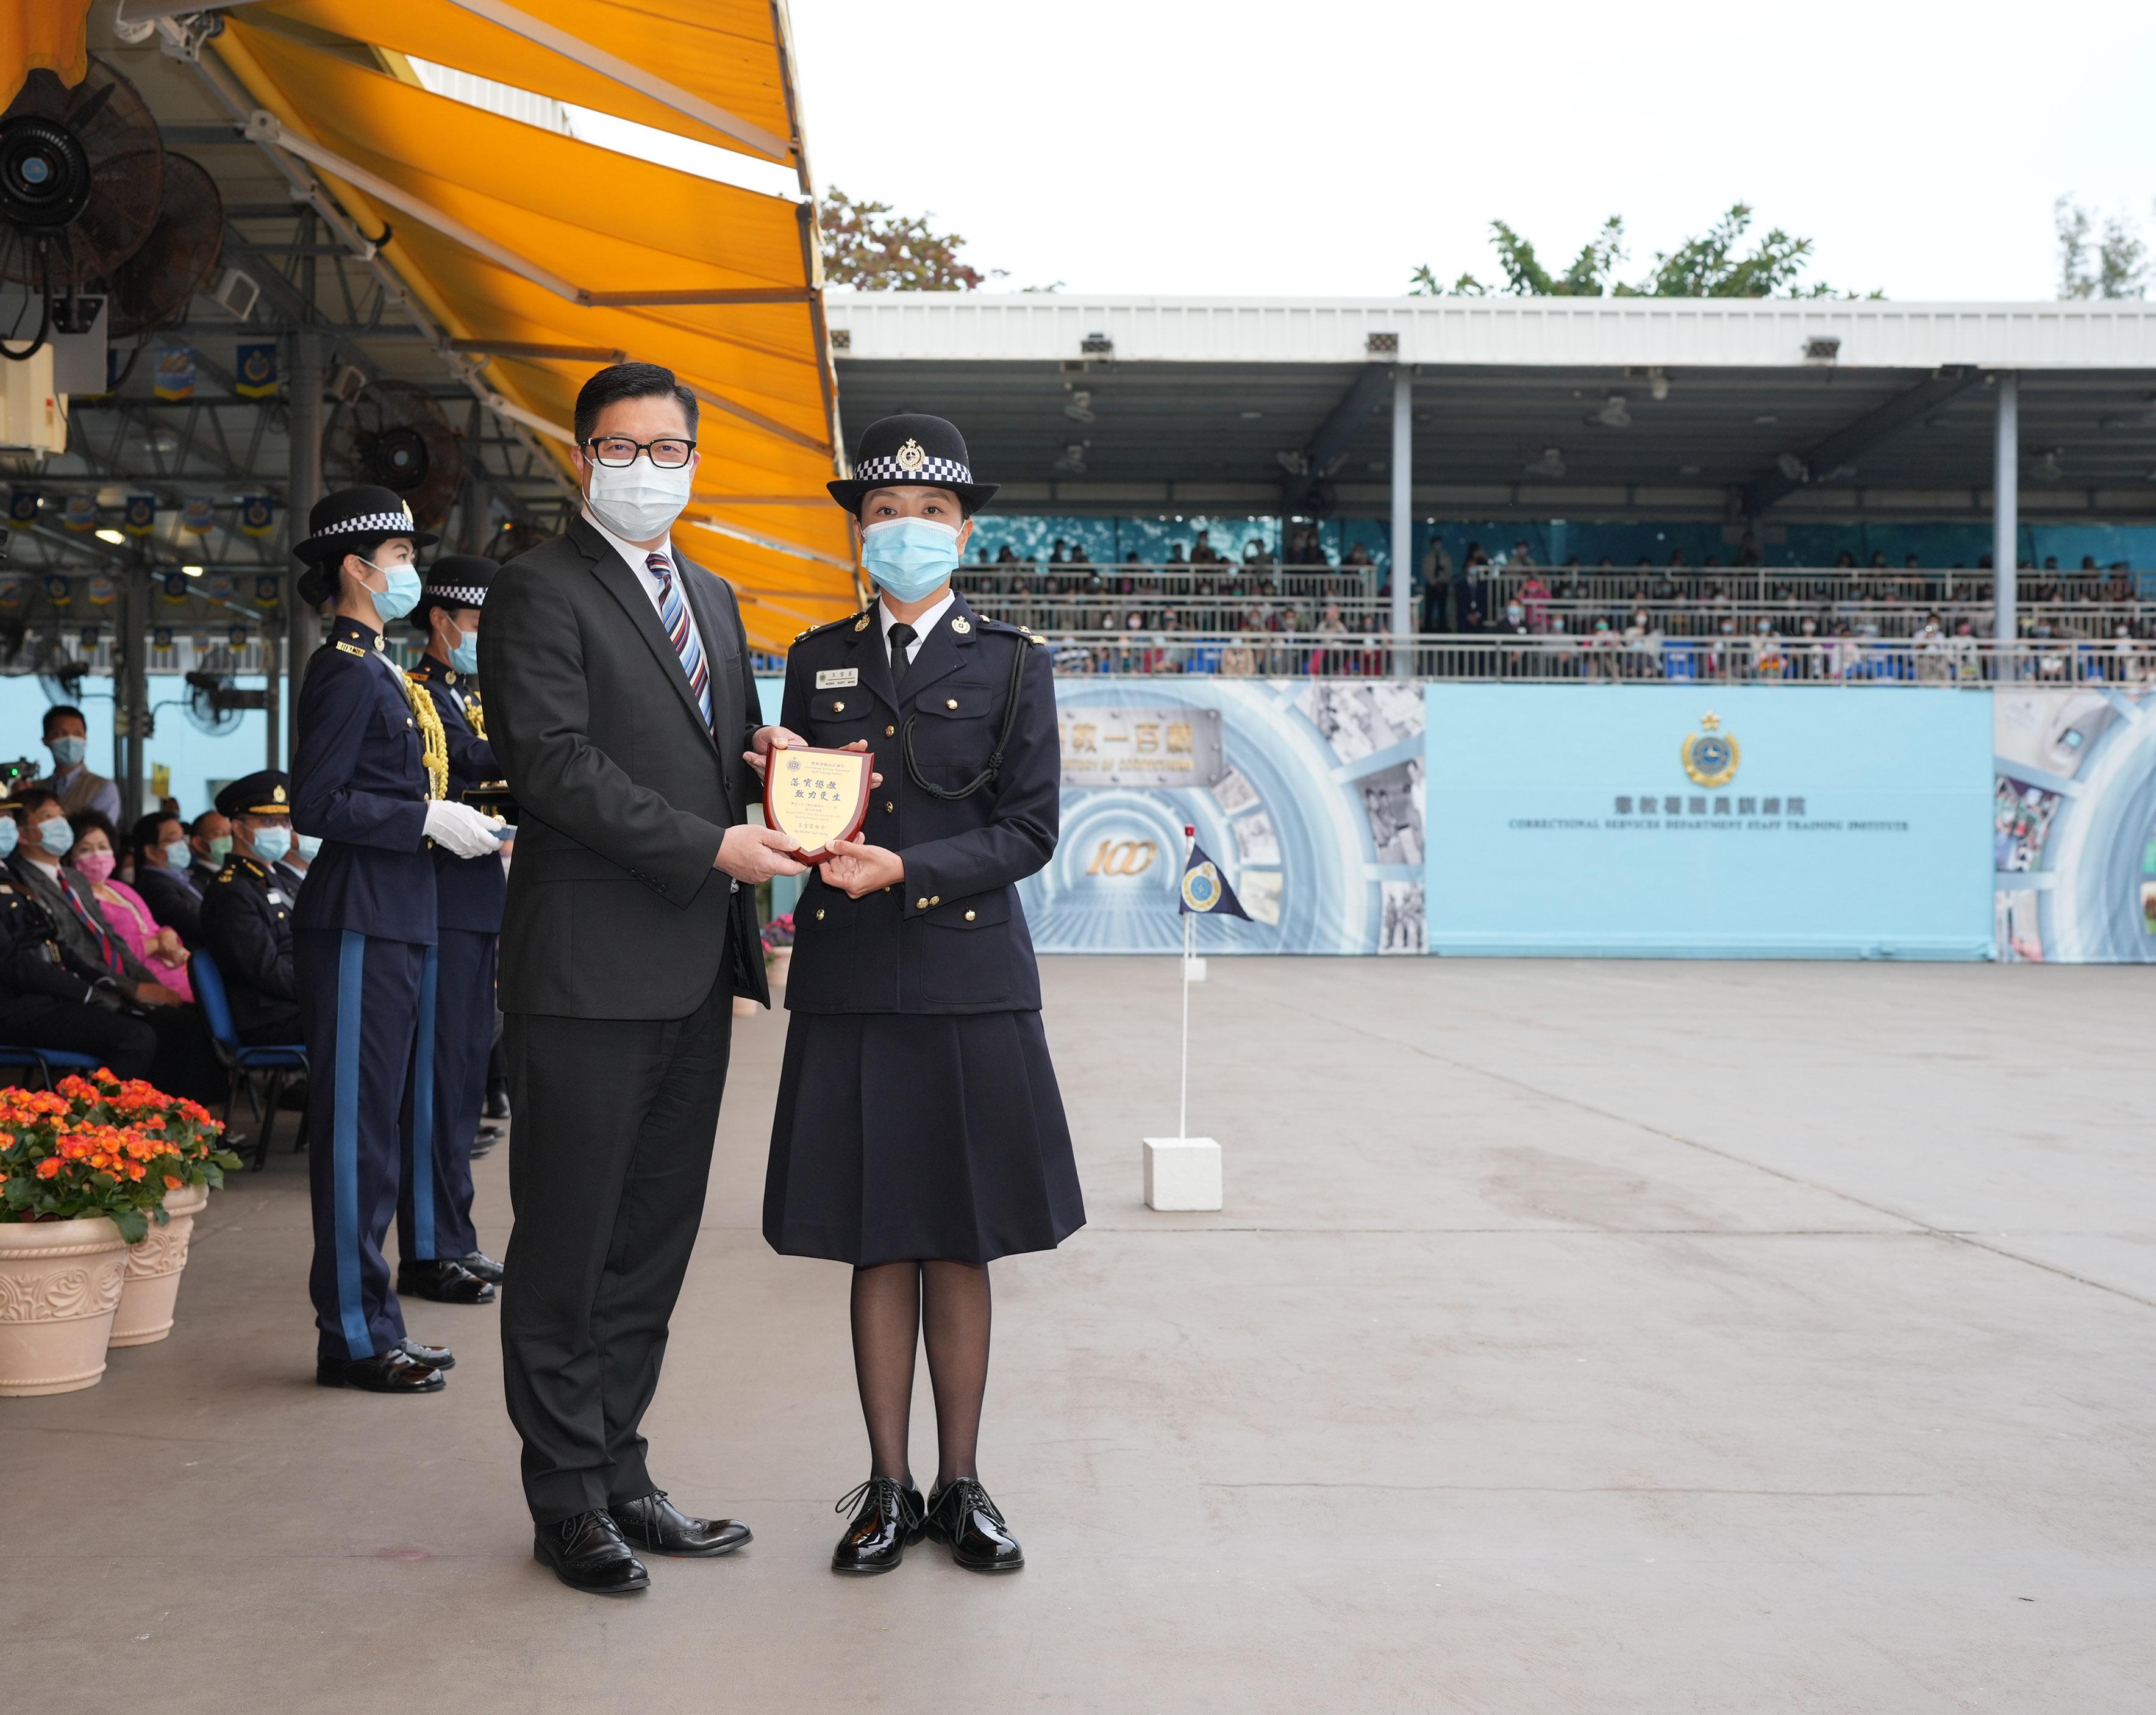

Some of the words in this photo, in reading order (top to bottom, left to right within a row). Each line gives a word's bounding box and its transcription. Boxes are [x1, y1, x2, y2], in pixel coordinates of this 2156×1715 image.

[795, 790, 841, 801] 致力更生
[1509, 819, 1599, 830] CORRECTIONAL
[1605, 819, 1660, 830] SERVICES
[1666, 819, 1742, 830] DEPARTMENT
[1747, 819, 1781, 831] STAFF
[1787, 819, 1843, 831] TRAINING
[1848, 820, 1909, 831] INSTITUTE
[1085, 839, 1157, 876] 100
